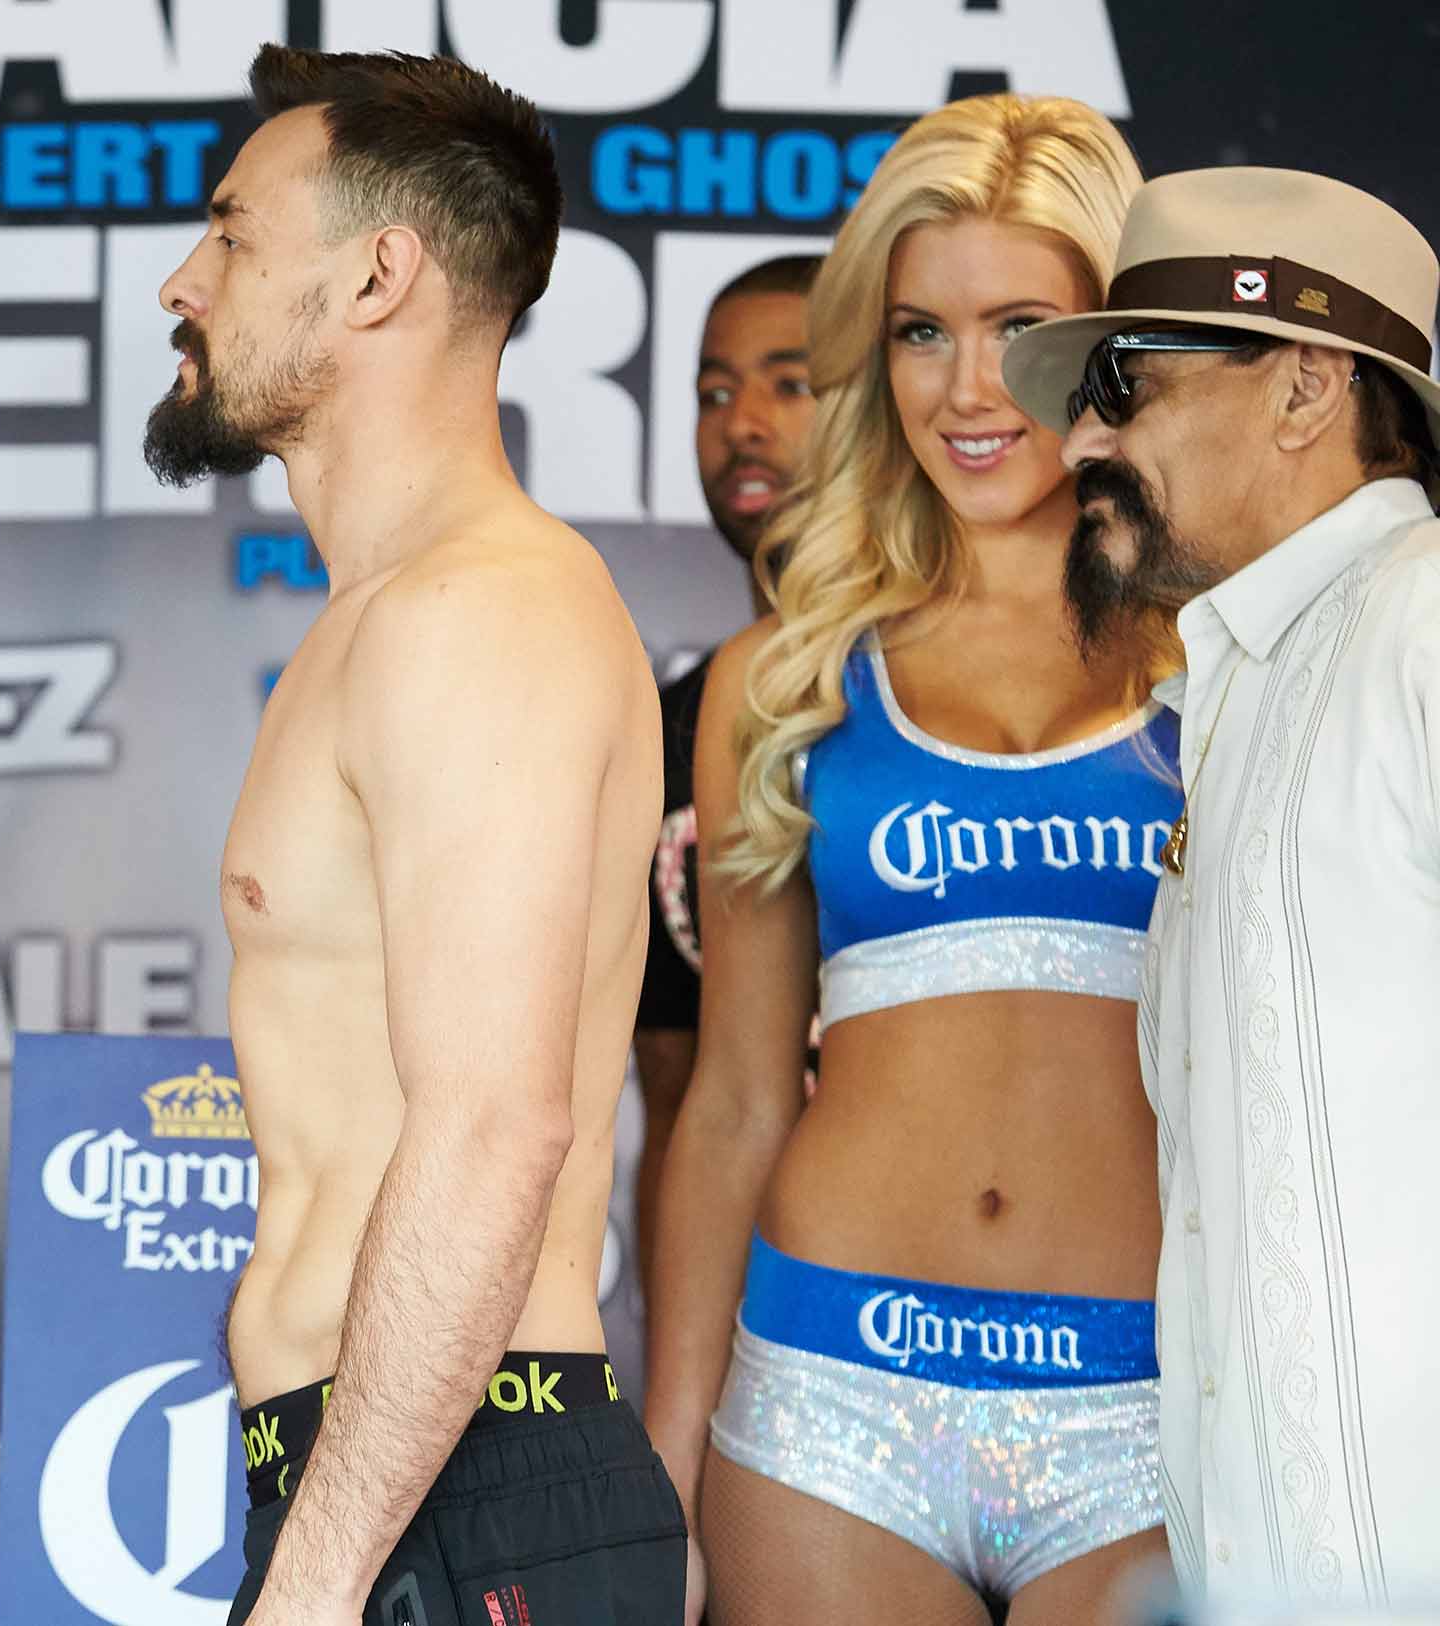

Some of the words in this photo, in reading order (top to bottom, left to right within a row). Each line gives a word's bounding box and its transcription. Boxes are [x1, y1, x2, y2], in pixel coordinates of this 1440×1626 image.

[41, 1127, 259, 1231] Coro
[123, 1209, 255, 1273] Extr
[857, 1290, 1083, 1370] Corona
